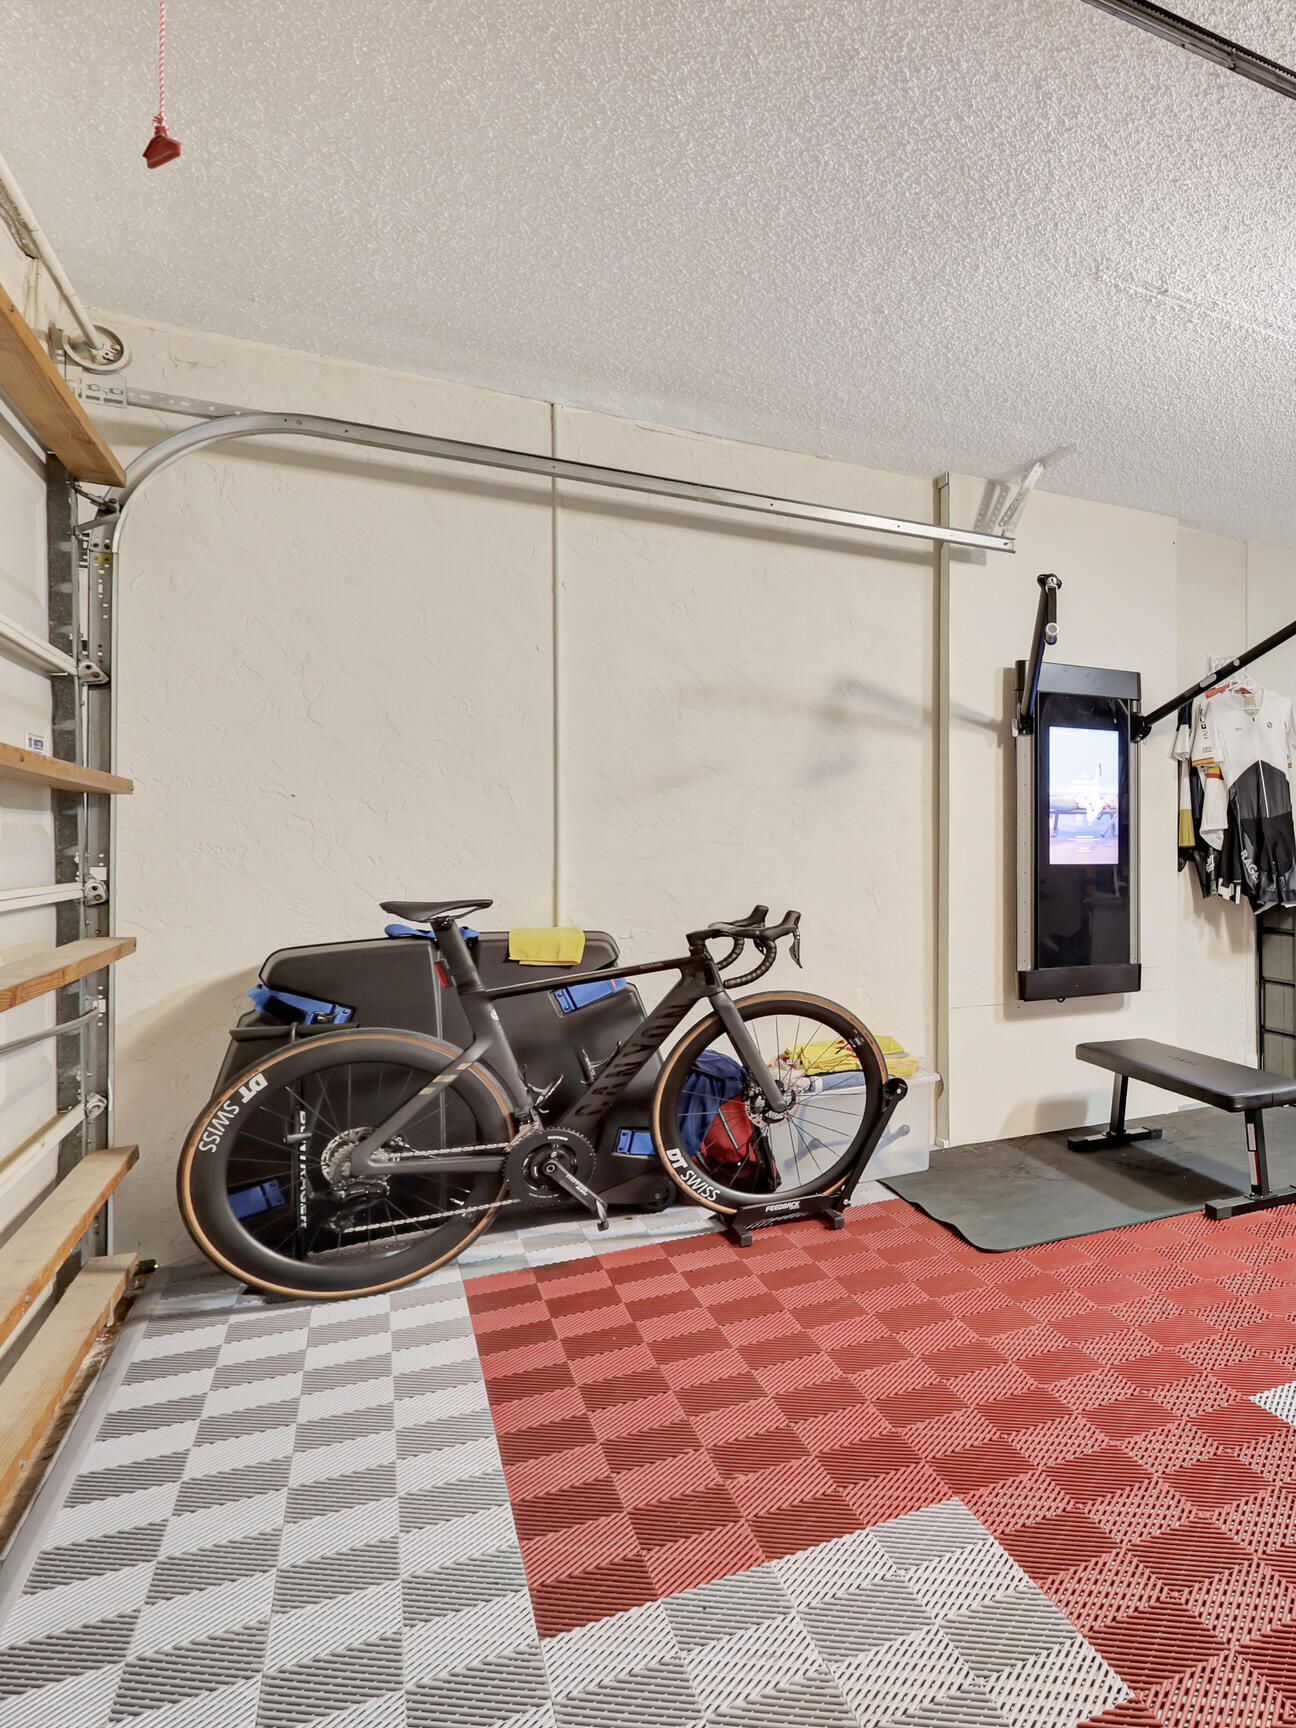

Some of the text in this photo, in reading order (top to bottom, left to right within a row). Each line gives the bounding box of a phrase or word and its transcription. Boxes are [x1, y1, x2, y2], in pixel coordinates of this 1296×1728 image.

[199, 1073, 269, 1153] DT SWISS
[666, 1148, 721, 1201] DT SWISS
